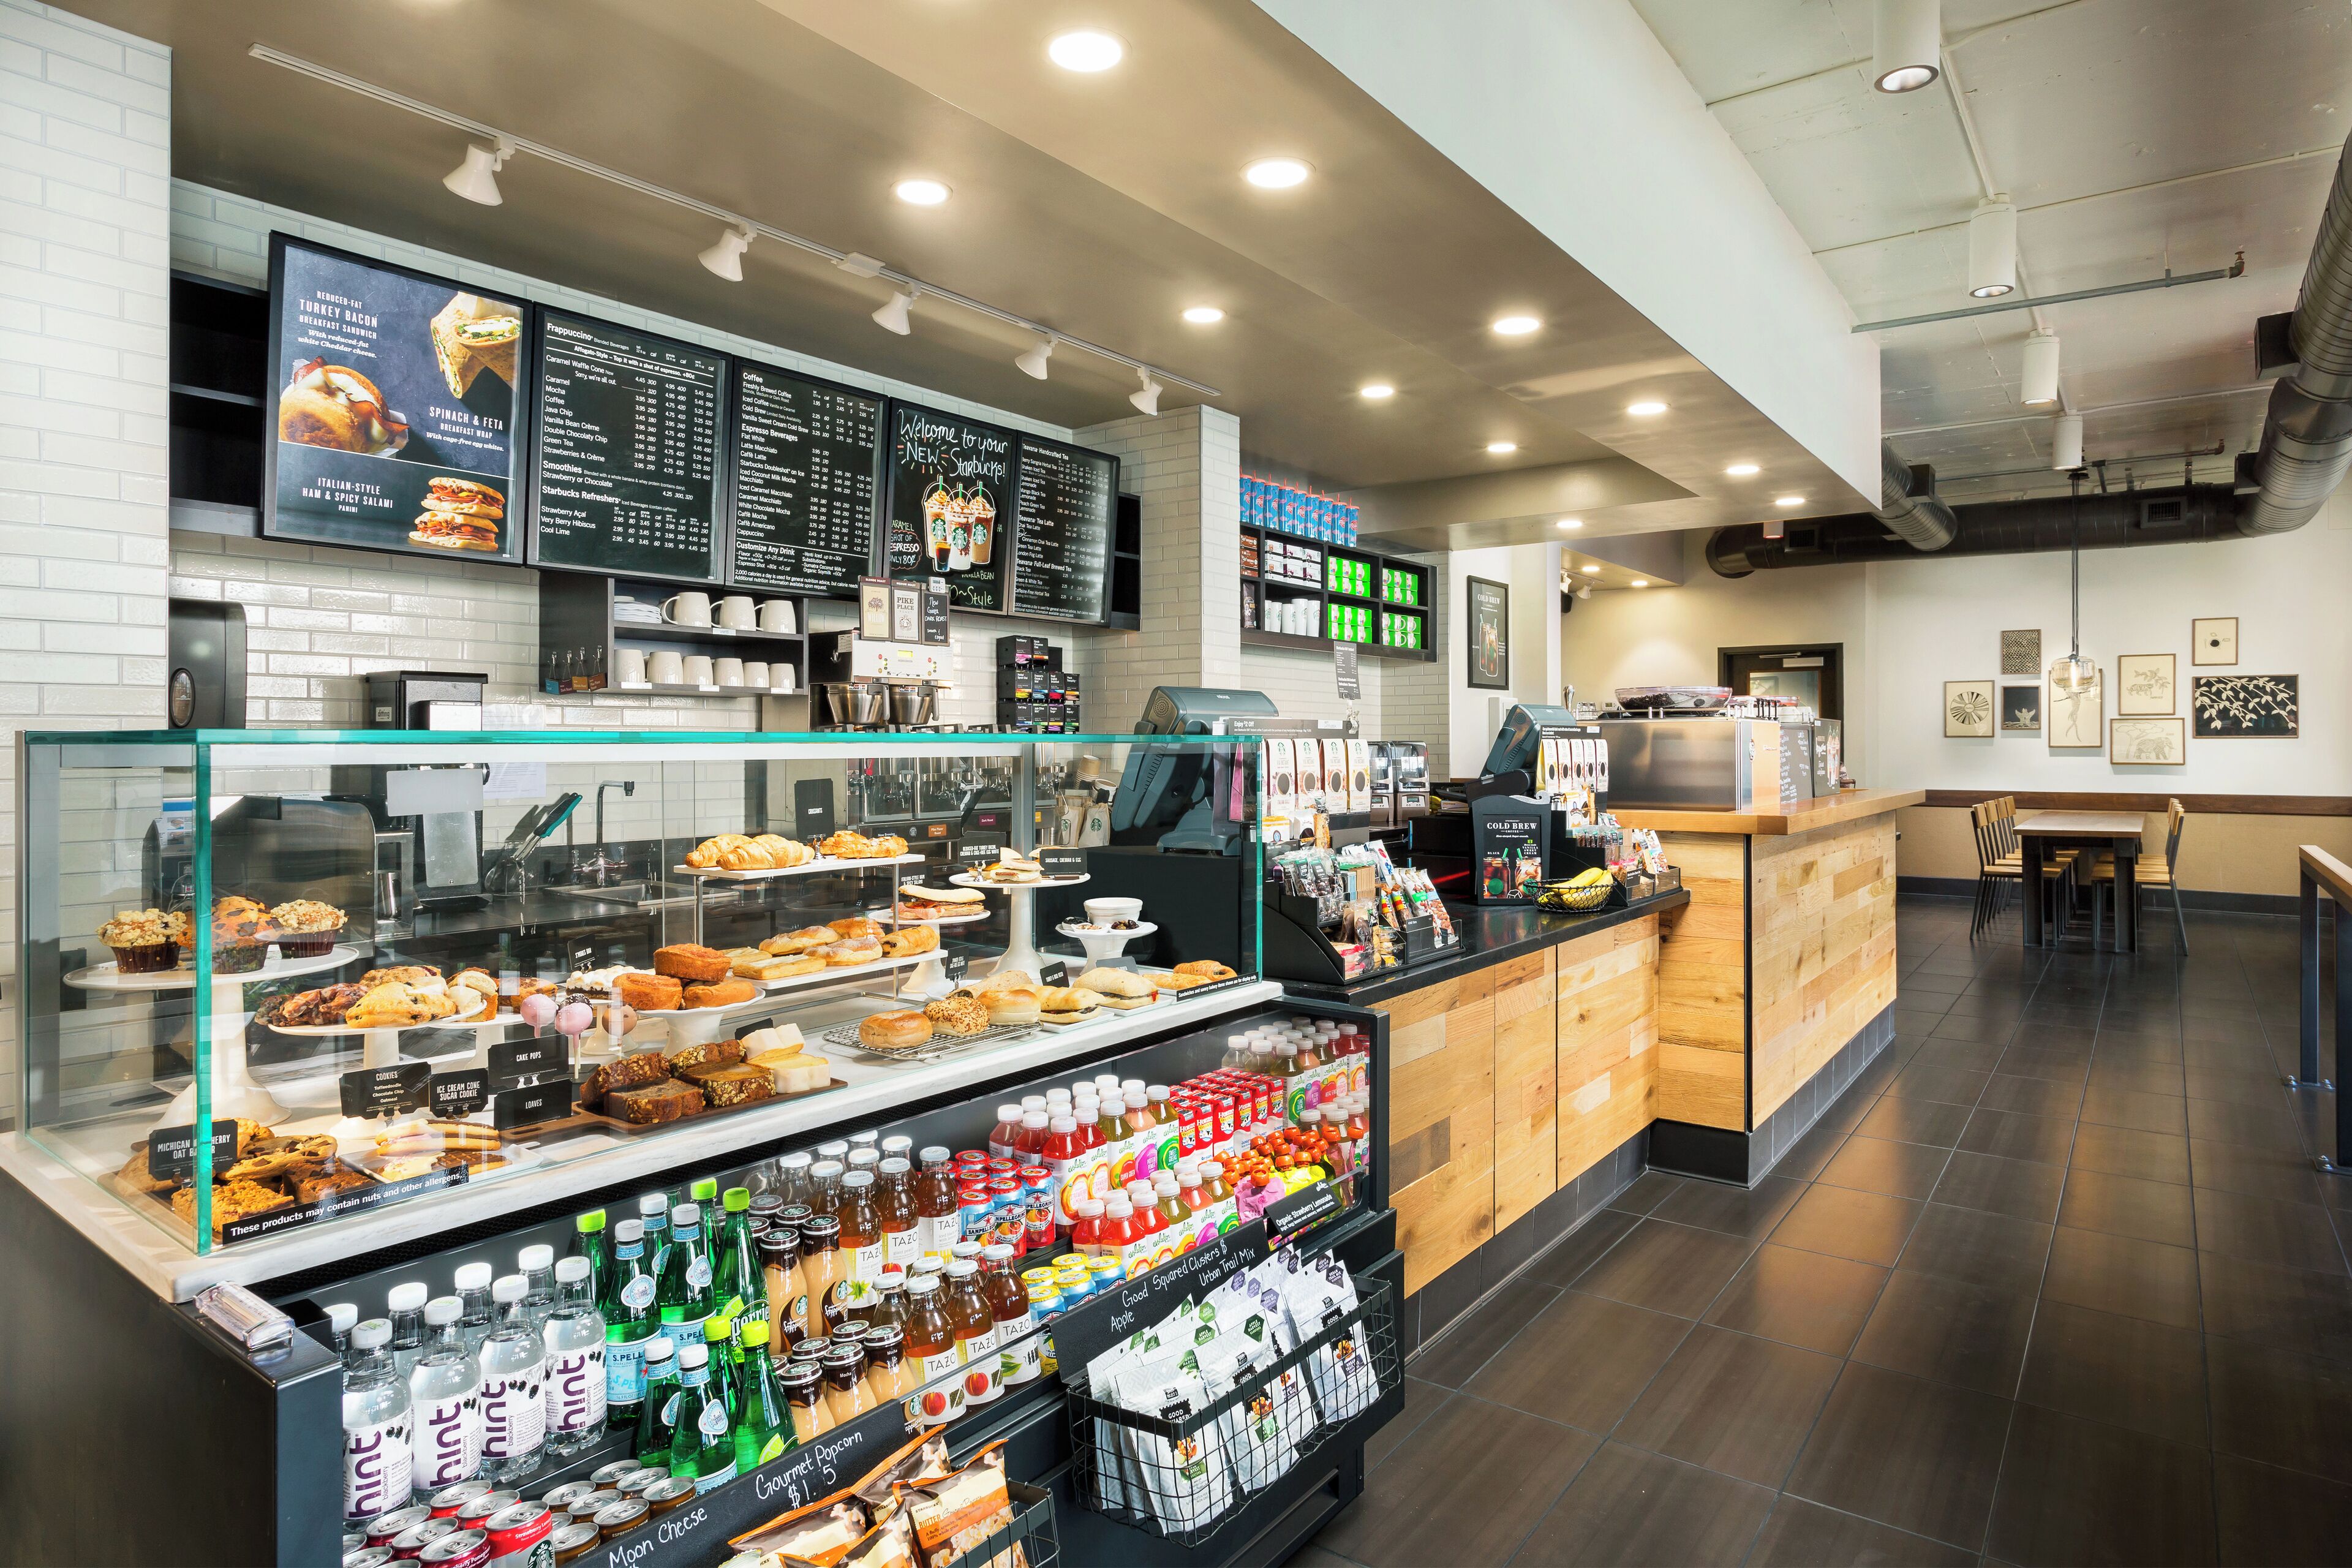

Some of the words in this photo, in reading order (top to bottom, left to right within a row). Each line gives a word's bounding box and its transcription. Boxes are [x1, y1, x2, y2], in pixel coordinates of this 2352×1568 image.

[316, 290, 362, 309] REDUCED-FAT
[299, 298, 340, 318] TURKEY
[345, 309, 377, 327] BACON
[298, 314, 339, 330] BREAKFAST
[342, 324, 376, 339] SANDWICH
[307, 328, 326, 338] With
[327, 334, 369, 347] reduced-fat
[297, 336, 319, 345] white
[320, 340, 352, 352] Cheddar
[352, 347, 377, 358] cheese.
[546, 354, 569, 365] Caramel
[568, 359, 586, 369] Waffle
[586, 364, 604, 373] Cone
[545, 385, 565, 394] Mocha
[429, 406, 469, 423] SPINACH
[472, 415, 478, 425] &
[483, 417, 502, 430] FETA
[559, 407, 573, 417] Chip
[440, 422, 473, 435] BREAKFAST
[476, 429, 492, 439] WRAP
[544, 415, 564, 424] Vanilla
[565, 418, 579, 428] Bean
[581, 421, 599, 431] Crème
[426, 431, 442, 440] With
[442, 435, 471, 445] cage-free
[544, 425, 563, 434] Double
[562, 429, 594, 441] Chocolaty
[594, 434, 607, 443] Chip
[897, 409, 958, 443] Welcome
[962, 428, 976, 448] to
[978, 437, 1008, 461] your
[907, 442, 938, 463] NEW
[542, 460, 582, 473] Smoothies
[317, 477, 380, 494] ITALIAN-STYLE
[541, 485, 579, 497] Starbucks
[302, 487, 320, 498] HAM
[325, 490, 330, 500] &
[334, 491, 359, 503] SPICY
[363, 496, 392, 508] SALAMI
[338, 504, 357, 513] PANINI
[891, 519, 914, 532] ARAMEL
[516, 1053, 529, 1062] CAKE
[529, 1050, 541, 1060] POPS
[375, 1071, 398, 1080] COOKIES
[439, 1091, 458, 1101] SUGAR
[459, 1088, 477, 1098] COOKIE
[447, 1083, 465, 1092] CREAM
[466, 1081, 480, 1091] CONE
[525, 1099, 542, 1109] LOAVES
[157, 1139, 190, 1152] MICHIGAN
[173, 1148, 186, 1159] OAT
[230, 1224, 259, 1237] These
[262, 1211, 303, 1231] products
[306, 1207, 324, 1222] may
[326, 1197, 360, 1213] contain
[362, 1193, 381, 1204] nuts
[383, 1186, 399, 1198] and
[401, 1181, 422, 1193] other
[424, 1172, 462, 1188] allergens.
[1276, 1212, 1293, 1226] Organic
[1291, 1202, 1314, 1219] Strawberry
[1311, 1193, 1333, 1208] Lemonade
[892, 1232, 918, 1247] TAZO
[1122, 1281, 1148, 1307] Good
[1153, 1262, 1188, 1291] Squared
[1188, 1247, 1220, 1270] Clusters
[1110, 1310, 1134, 1332] Apple
[1199, 1267, 1221, 1286] Urban
[1219, 1253, 1238, 1273] Trail
[1240, 1248, 1255, 1263] Mix
[1003, 1319, 1030, 1336] TAZO
[970, 1334, 995, 1354] TAZO
[928, 1352, 956, 1372] TAZO
[557, 1354, 586, 1431] hint
[481, 1380, 507, 1457] hint
[1168, 1409, 1183, 1419] GOOD
[429, 1401, 461, 1487] hint
[348, 1430, 382, 1518] hint
[756, 1453, 812, 1500] Gourmet
[814, 1431, 862, 1465] Popcorn
[918, 1514, 941, 1529] BUTTER
[514, 1525, 541, 1539] Strawberry
[609, 1539, 654, 1568] Moon
[657, 1507, 707, 1544] Cheese
